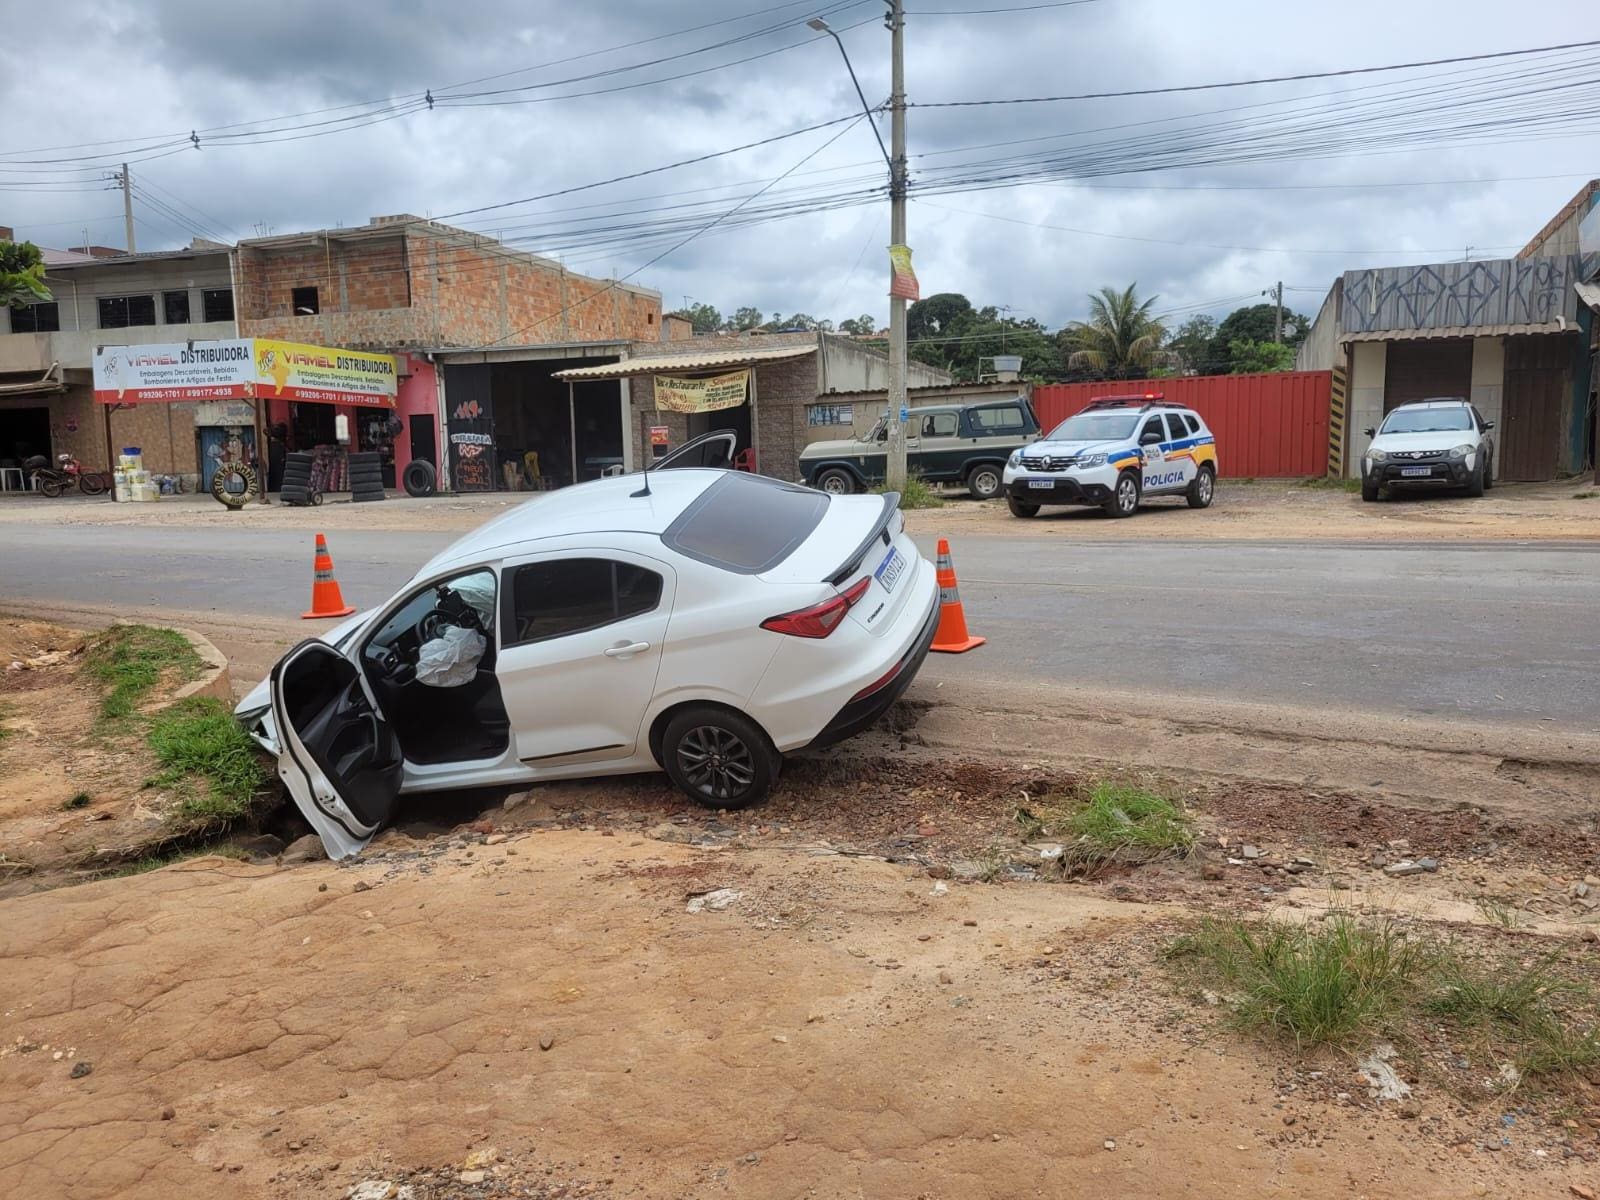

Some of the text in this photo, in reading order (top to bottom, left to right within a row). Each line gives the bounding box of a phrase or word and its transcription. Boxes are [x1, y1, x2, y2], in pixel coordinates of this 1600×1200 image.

[126, 346, 249, 368] VIRMEL DISTRIBUIDORA
[283, 351, 393, 375] VIRMEL DISTRIBUIDORA
[139, 369, 173, 379] Embalagens
[186, 375, 206, 385] Artigos
[207, 375, 215, 383] de
[341, 381, 359, 390] Artigos
[142, 389, 181, 399] 99206-1701
